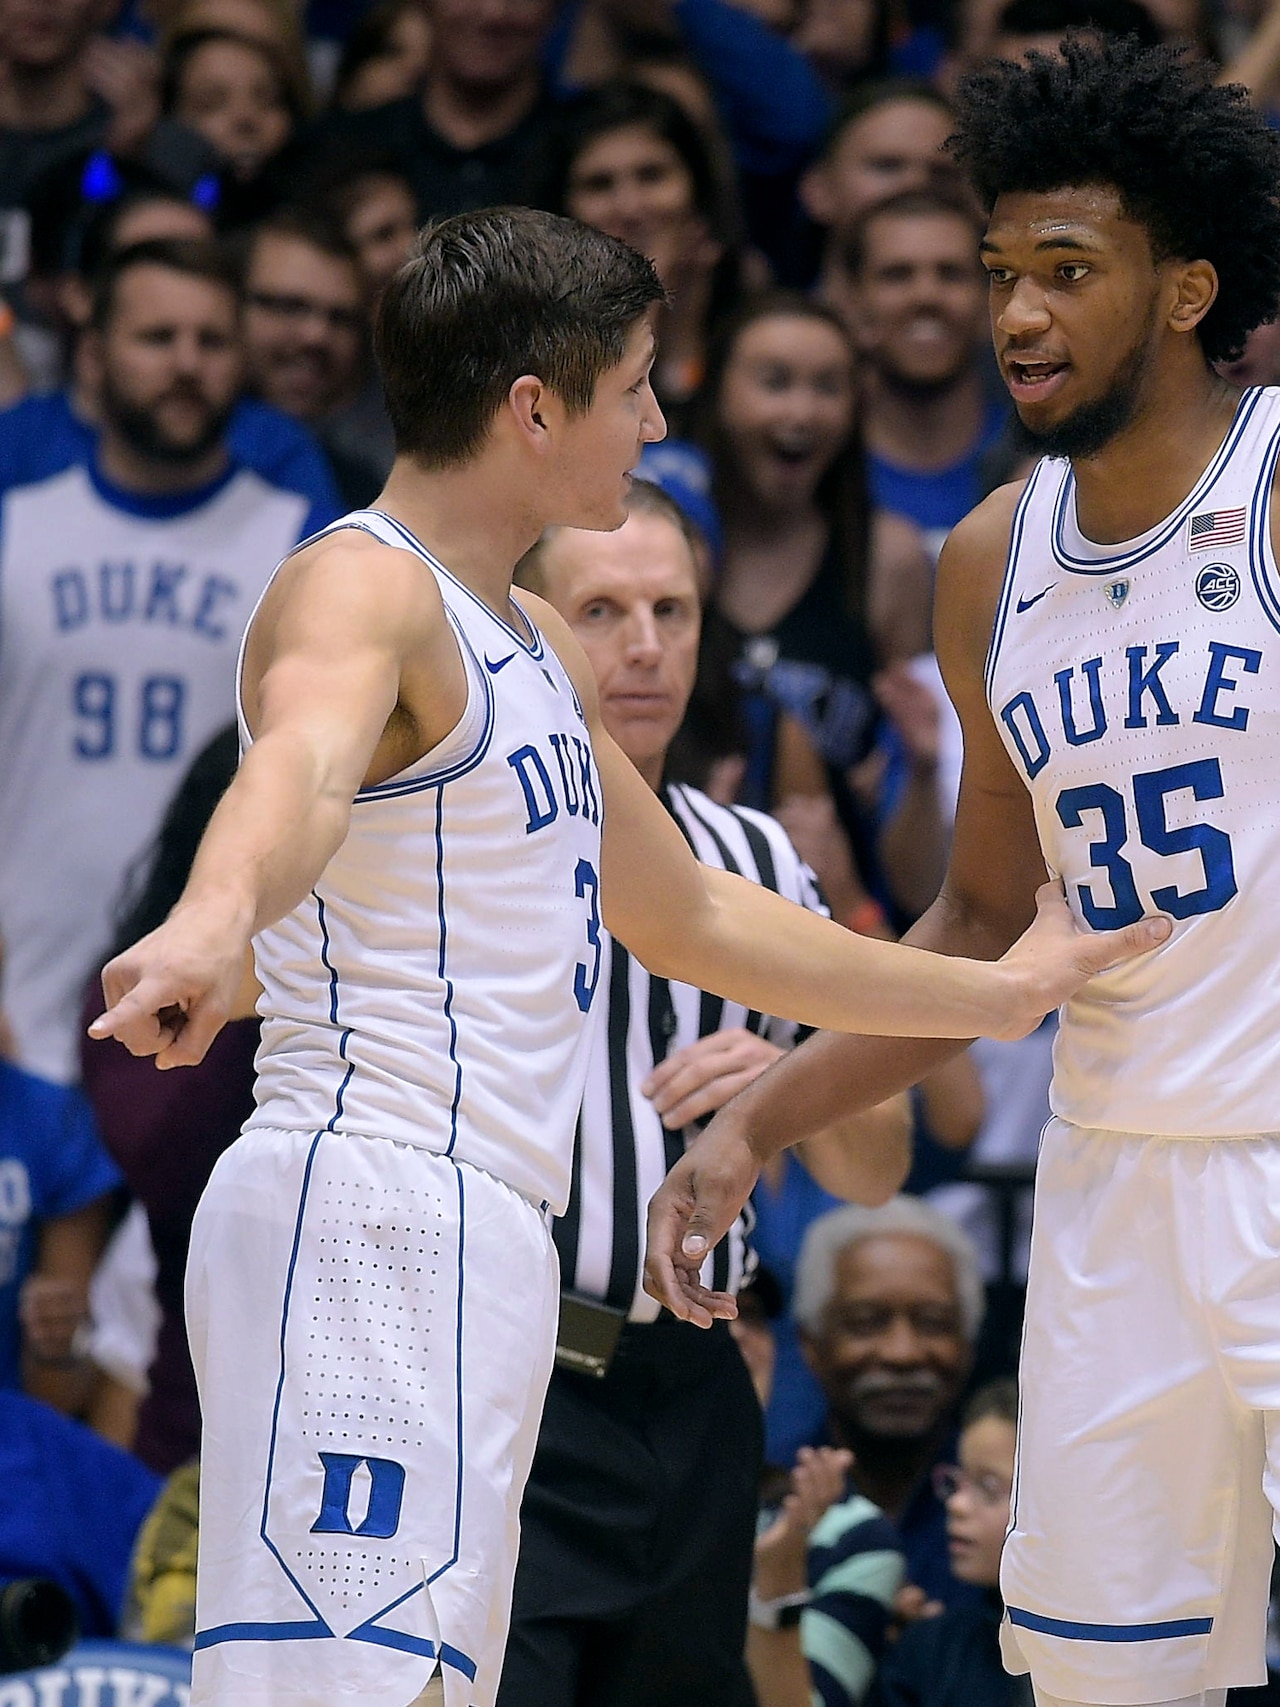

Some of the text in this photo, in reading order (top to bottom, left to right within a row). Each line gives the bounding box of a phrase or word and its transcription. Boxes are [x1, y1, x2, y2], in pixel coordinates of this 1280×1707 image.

[53, 561, 239, 641] DUKE
[1203, 577, 1236, 590] ACC
[73, 669, 189, 762] 98
[1000, 641, 1263, 781] DUKE
[507, 733, 604, 834] DUK
[1055, 757, 1239, 931] 35
[309, 1451, 406, 1540] D
